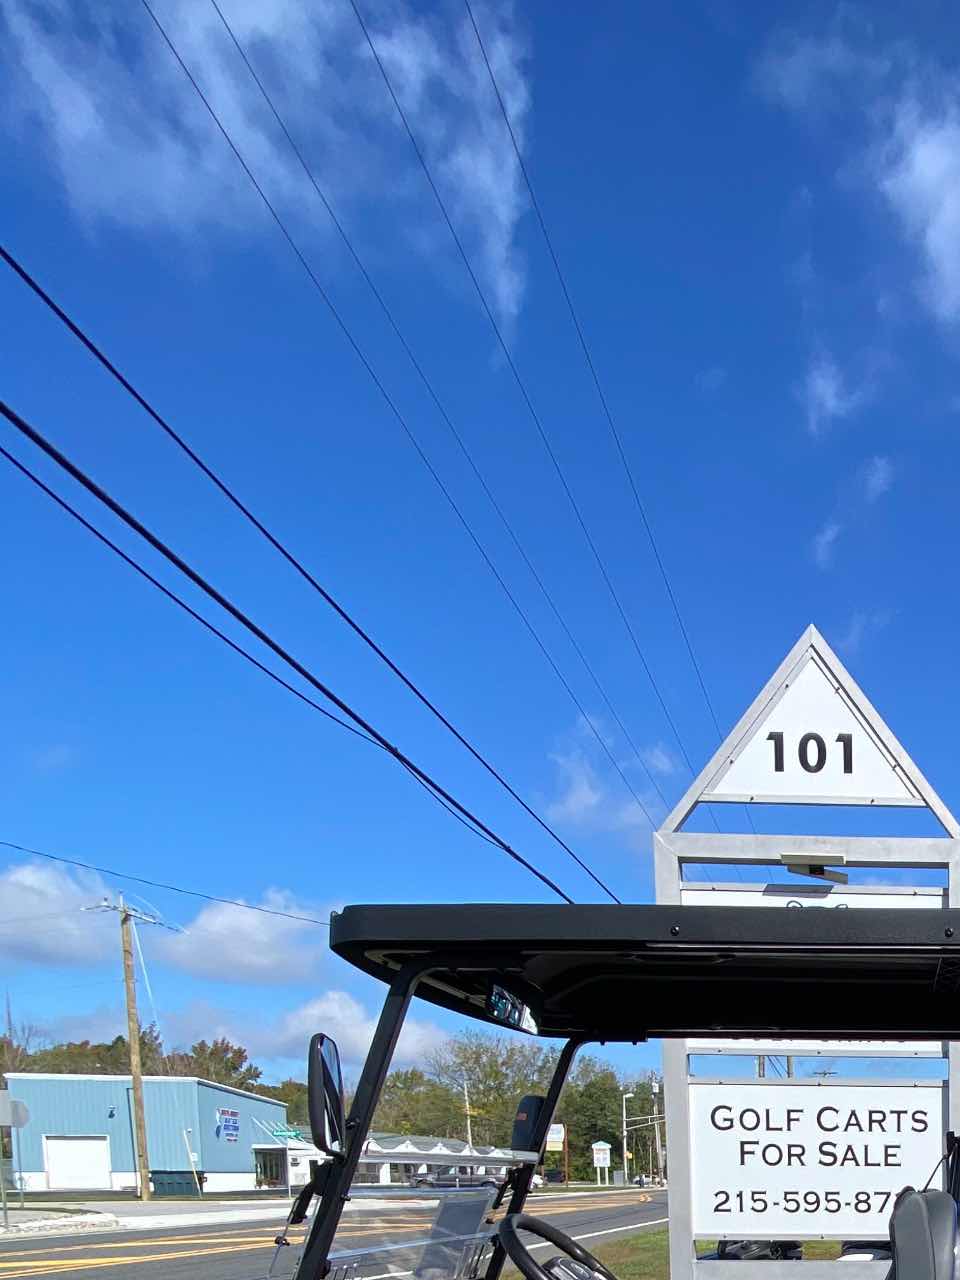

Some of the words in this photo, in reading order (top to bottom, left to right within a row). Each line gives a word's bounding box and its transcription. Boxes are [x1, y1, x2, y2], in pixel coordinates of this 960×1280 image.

[766, 731, 853, 774] 101
[710, 1105, 804, 1132] GOLF
[816, 1106, 929, 1133] CARTS
[739, 1140, 806, 1167] FOR
[818, 1141, 902, 1167] SALE
[713, 1190, 892, 1214] 215-595-87
